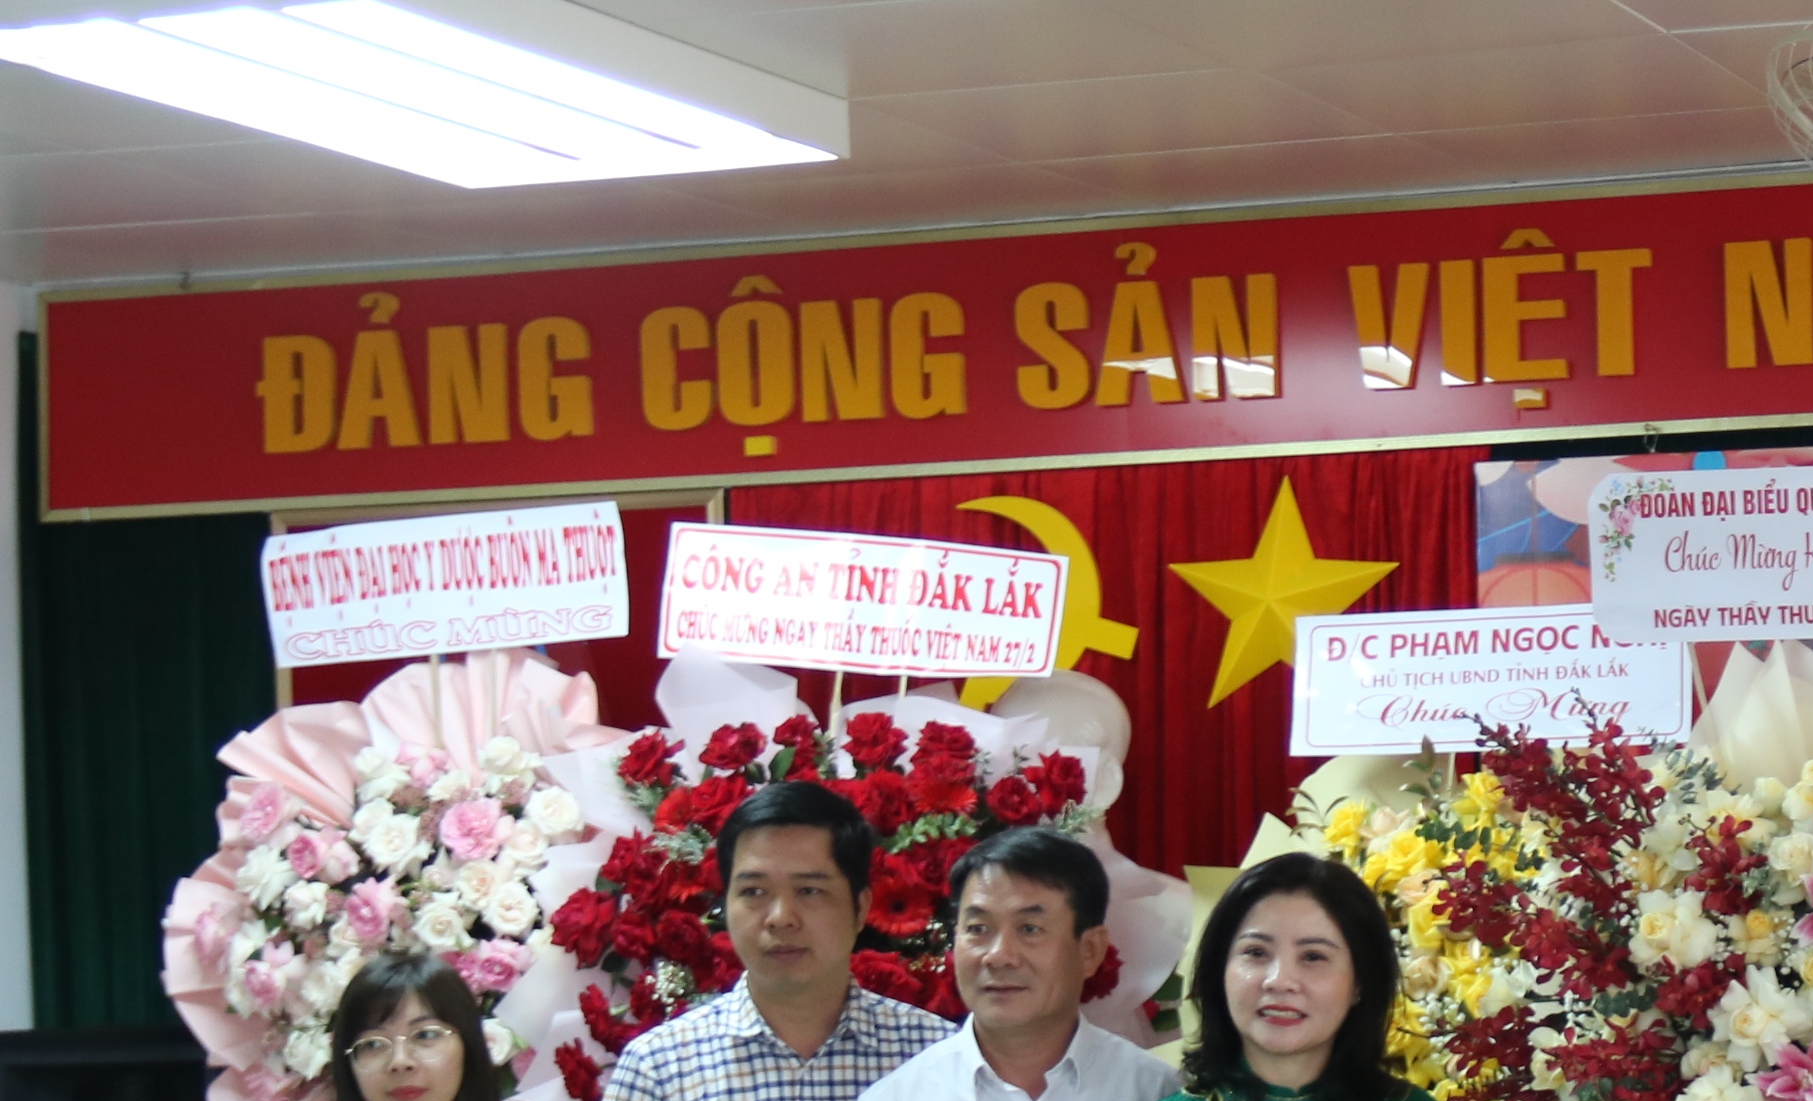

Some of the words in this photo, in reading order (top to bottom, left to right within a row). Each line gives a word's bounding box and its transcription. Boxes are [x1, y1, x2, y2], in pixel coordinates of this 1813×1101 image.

[256, 292, 595, 454] ĐẢNG
[639, 274, 968, 458] CỘNG
[1014, 241, 1279, 410] SẢN
[1347, 228, 1653, 409] VIỆT
[1702, 490, 1736, 522] ĐẠI
[1743, 478, 1789, 515] BIỂU
[424, 540, 434, 591] Y
[487, 515, 532, 589] BUÔN
[534, 527, 561, 585] MA
[1665, 530, 1722, 572] Chúc
[1727, 533, 1799, 591] Mừng
[682, 543, 764, 593] CÔNG
[773, 562, 819, 597] AN
[828, 547, 899, 605] TỈNH
[907, 550, 973, 611] ĐẮK
[981, 558, 1043, 619] LẮK
[1654, 605, 1711, 628] NGÀY
[1717, 600, 1771, 626] THẦY
[284, 618, 438, 661] CHÚC
[964, 633, 1001, 663] NAM
[1003, 638, 1036, 669] 27/2
[1390, 630, 1480, 660] PHẠM
[1491, 625, 1580, 655] NGỌC
[1404, 671, 1444, 689] TỊCH
[1450, 669, 1500, 685] UBND
[1506, 662, 1550, 681] TỈNH
[1555, 658, 1592, 680] ĐẮK
[1597, 657, 1630, 678] LẮK
[1356, 694, 1467, 730] Chúc
